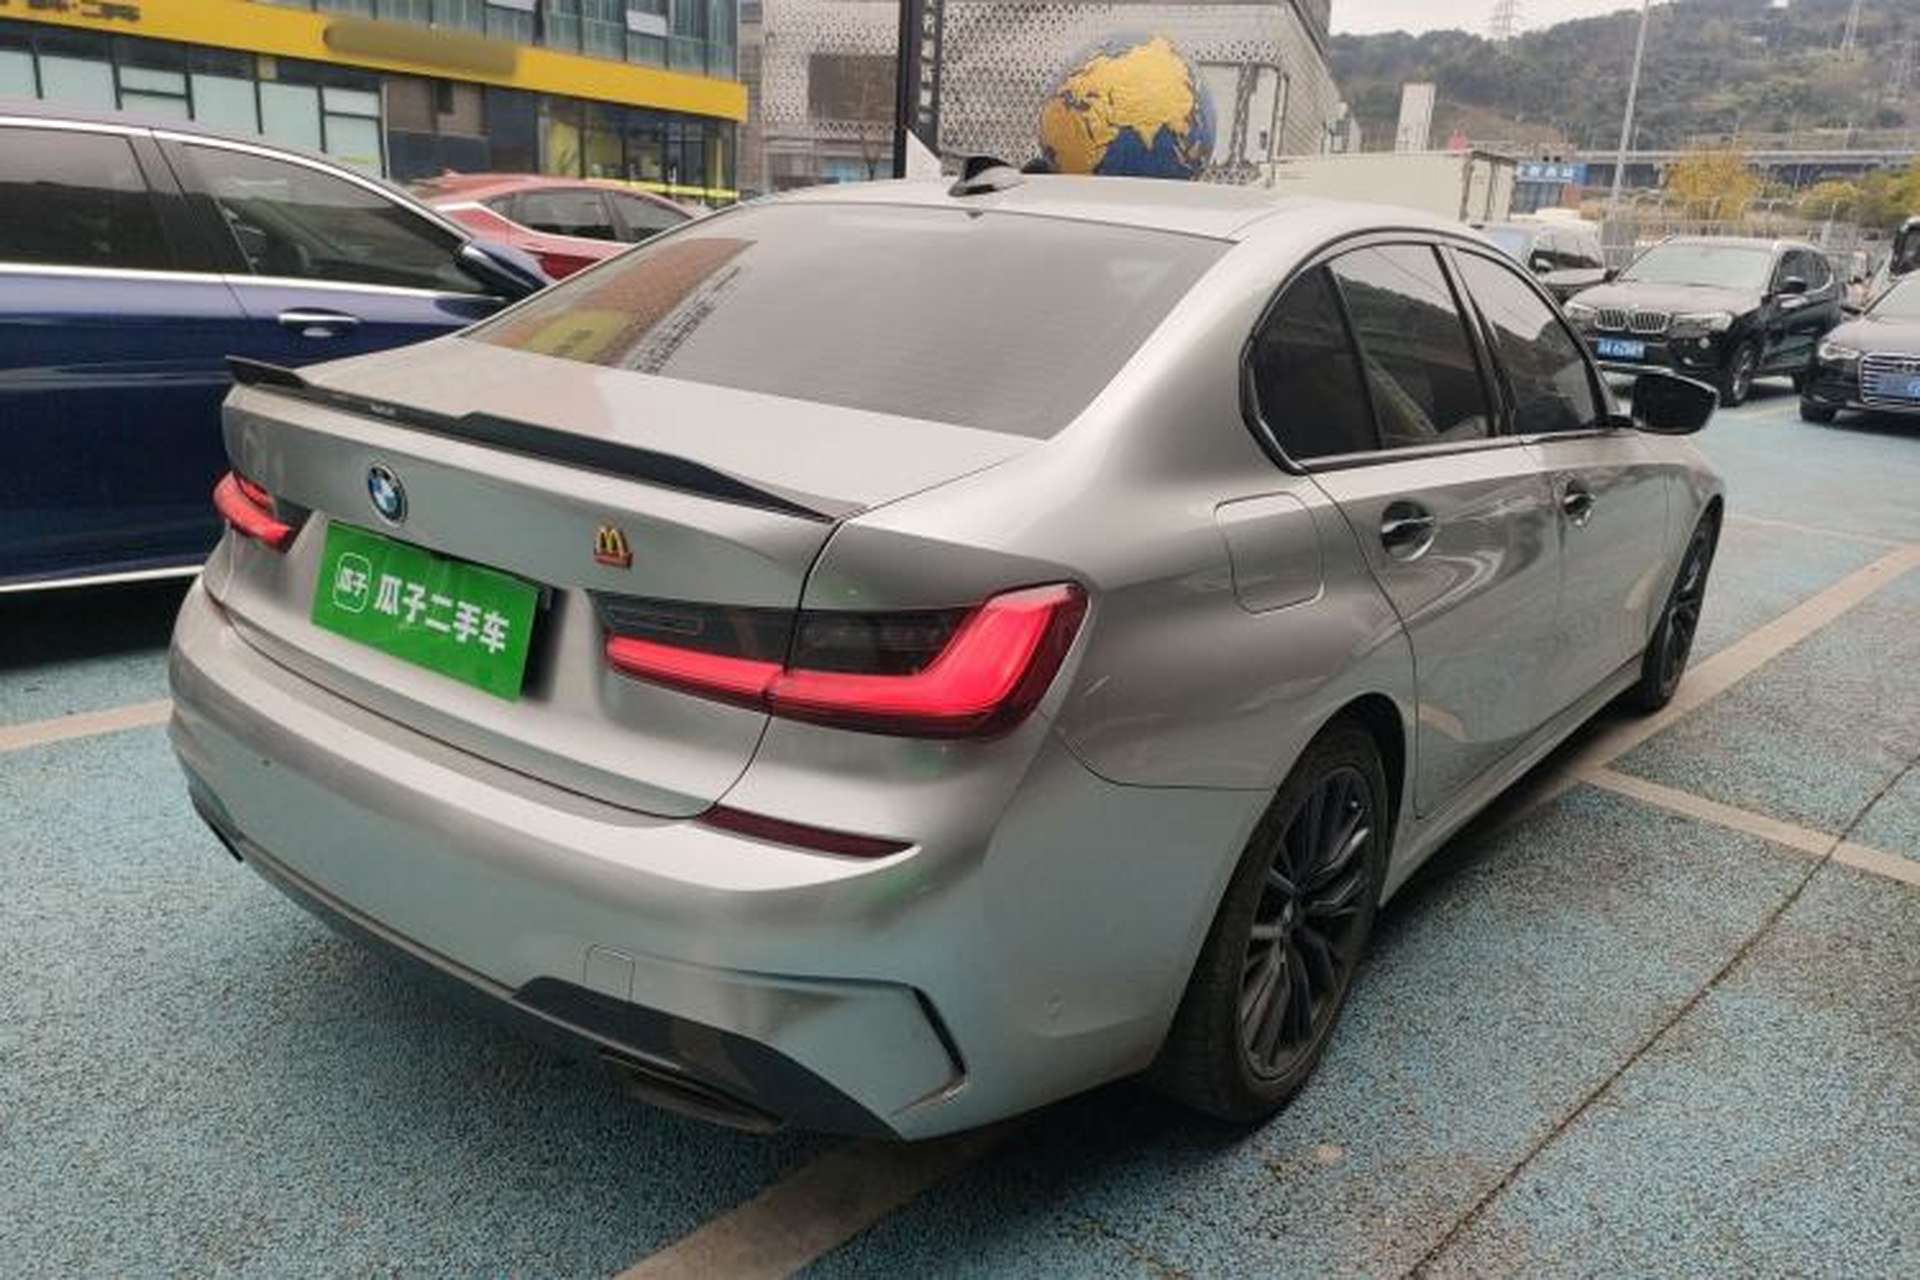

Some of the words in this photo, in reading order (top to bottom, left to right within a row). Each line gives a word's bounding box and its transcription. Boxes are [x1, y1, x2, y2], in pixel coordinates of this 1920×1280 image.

[373, 572, 510, 654] 瓜子二手车
